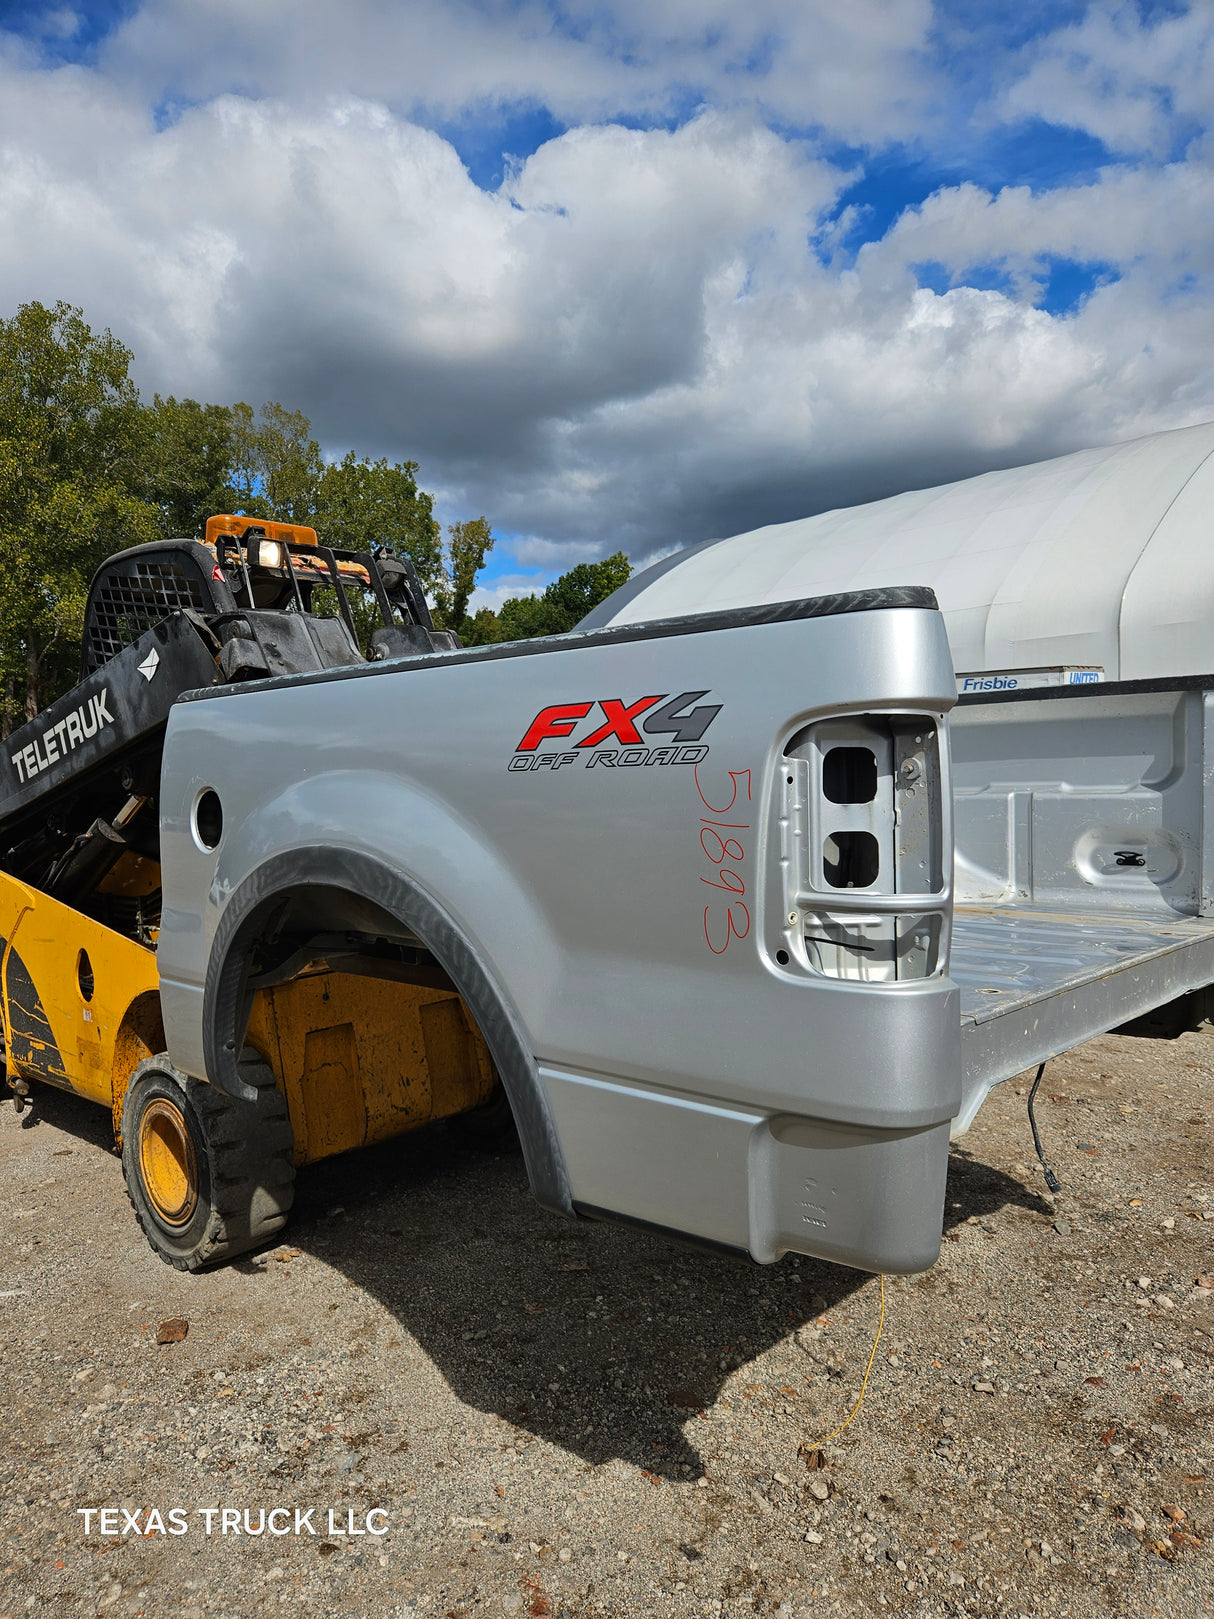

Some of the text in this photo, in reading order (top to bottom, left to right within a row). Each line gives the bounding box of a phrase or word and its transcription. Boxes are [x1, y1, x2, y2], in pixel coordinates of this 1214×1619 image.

[963, 676, 1018, 691] Frisbie
[1069, 671, 1099, 684] UNITED
[11, 687, 115, 784] TELETRUK
[514, 689, 724, 752] FX4
[507, 744, 710, 772] OFF ROAD
[694, 764, 752, 955] 51893
